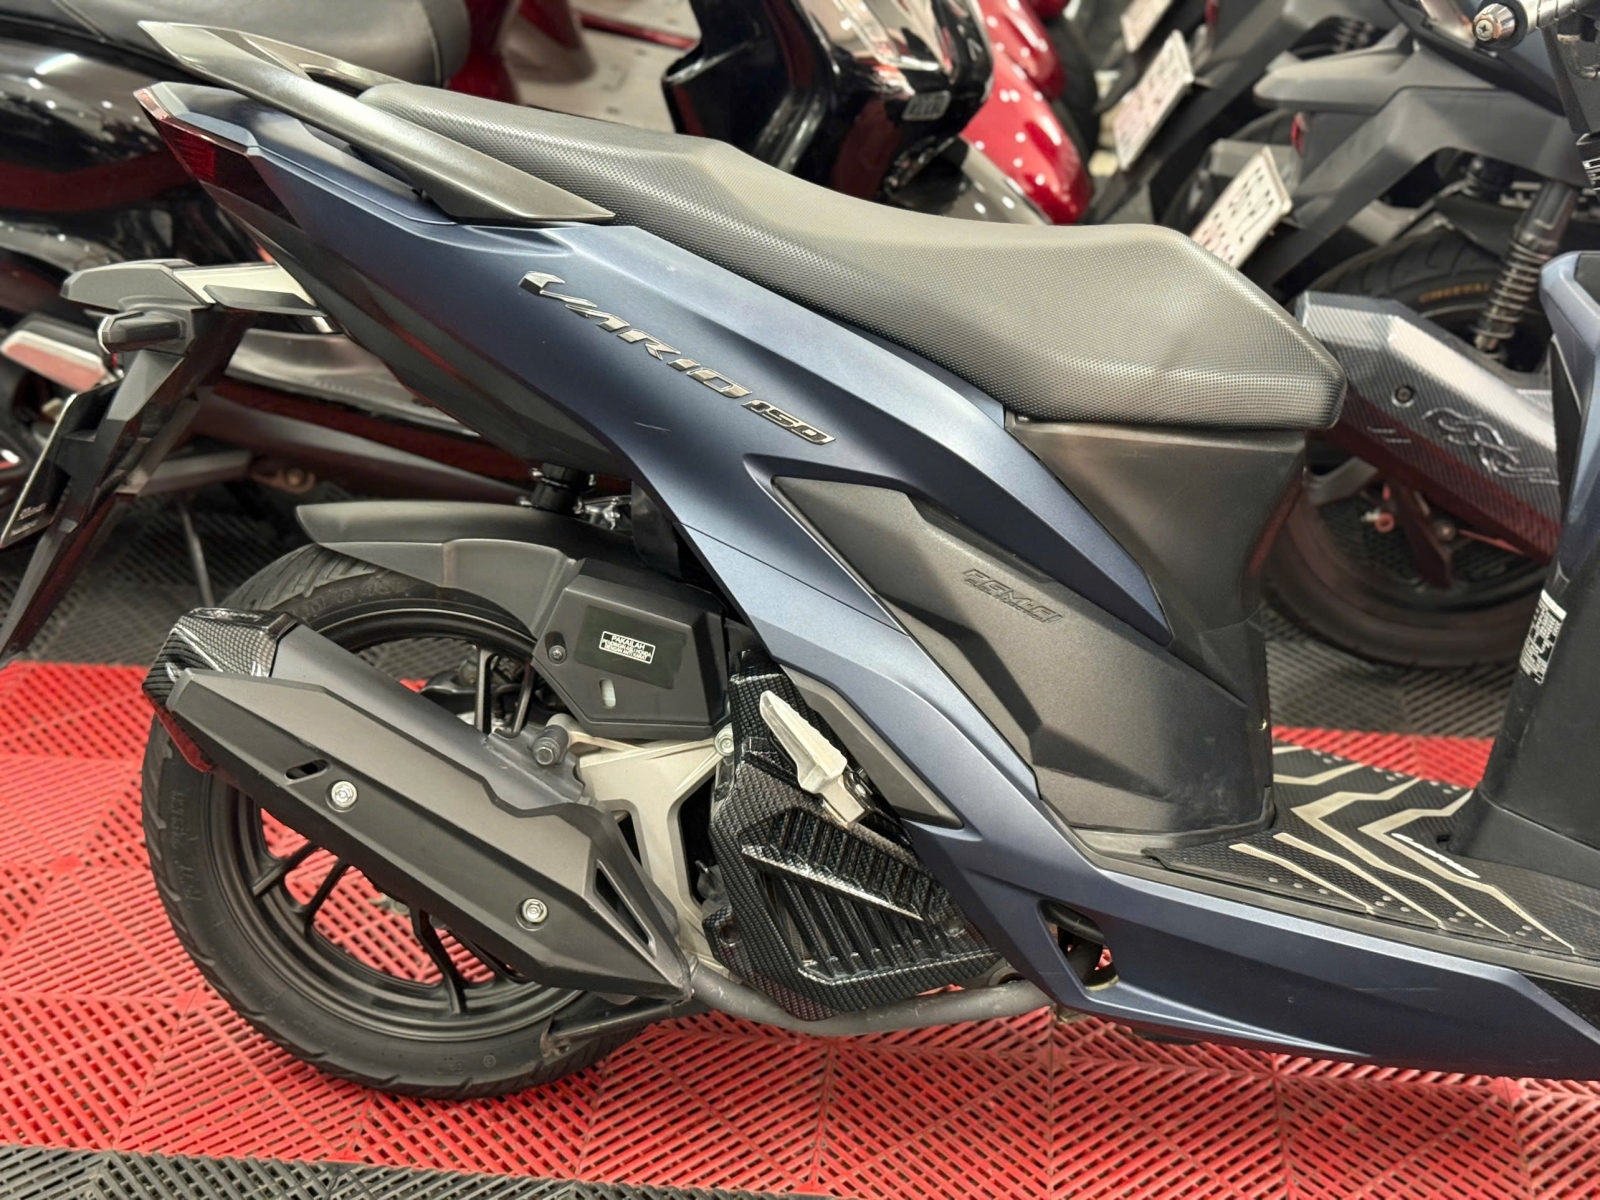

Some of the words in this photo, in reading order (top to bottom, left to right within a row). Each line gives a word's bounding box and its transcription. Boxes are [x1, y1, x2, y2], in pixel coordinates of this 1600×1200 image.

[518, 270, 753, 399] VARIO
[740, 399, 836, 445] 150
[611, 635, 646, 650] PAKAILAH
